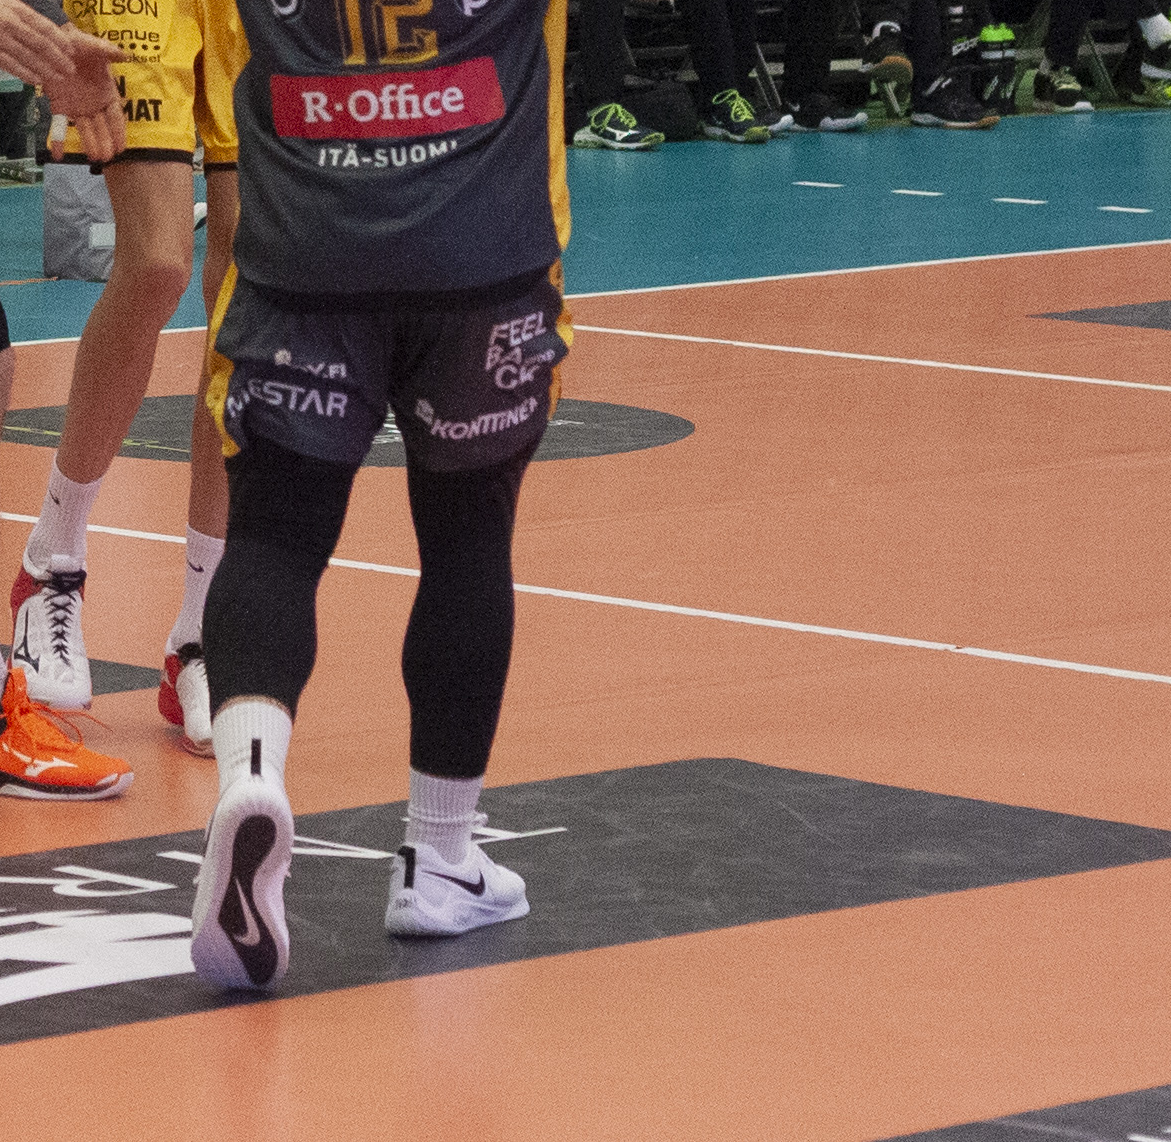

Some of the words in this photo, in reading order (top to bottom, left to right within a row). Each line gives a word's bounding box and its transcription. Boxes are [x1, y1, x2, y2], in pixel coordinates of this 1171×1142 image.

[93, 29, 161, 43] venue
[122, 98, 163, 122] MAT
[489, 310, 547, 347] FEEL
